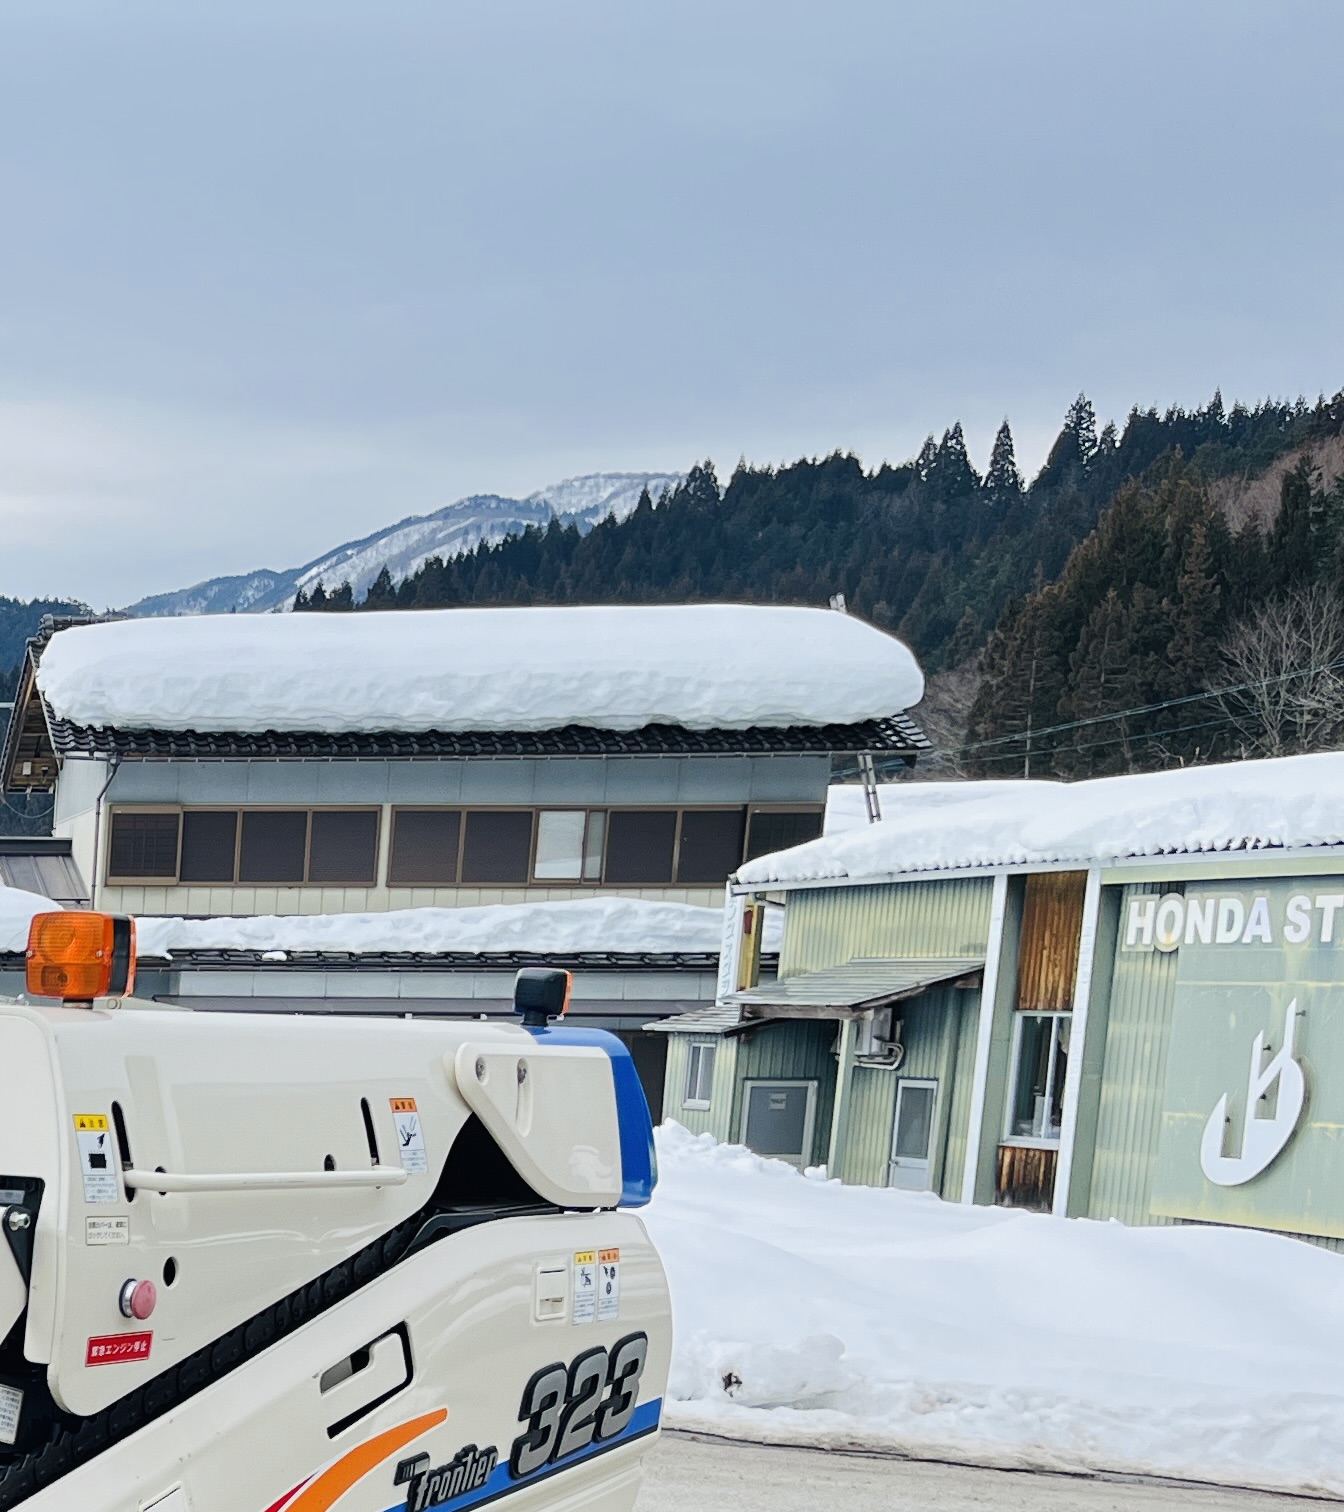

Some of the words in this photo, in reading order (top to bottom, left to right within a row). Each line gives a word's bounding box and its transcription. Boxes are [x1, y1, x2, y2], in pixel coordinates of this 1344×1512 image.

[1126, 896, 1273, 946] HONDA
[1283, 894, 1344, 944] ST
[509, 1330, 648, 1480] 323
